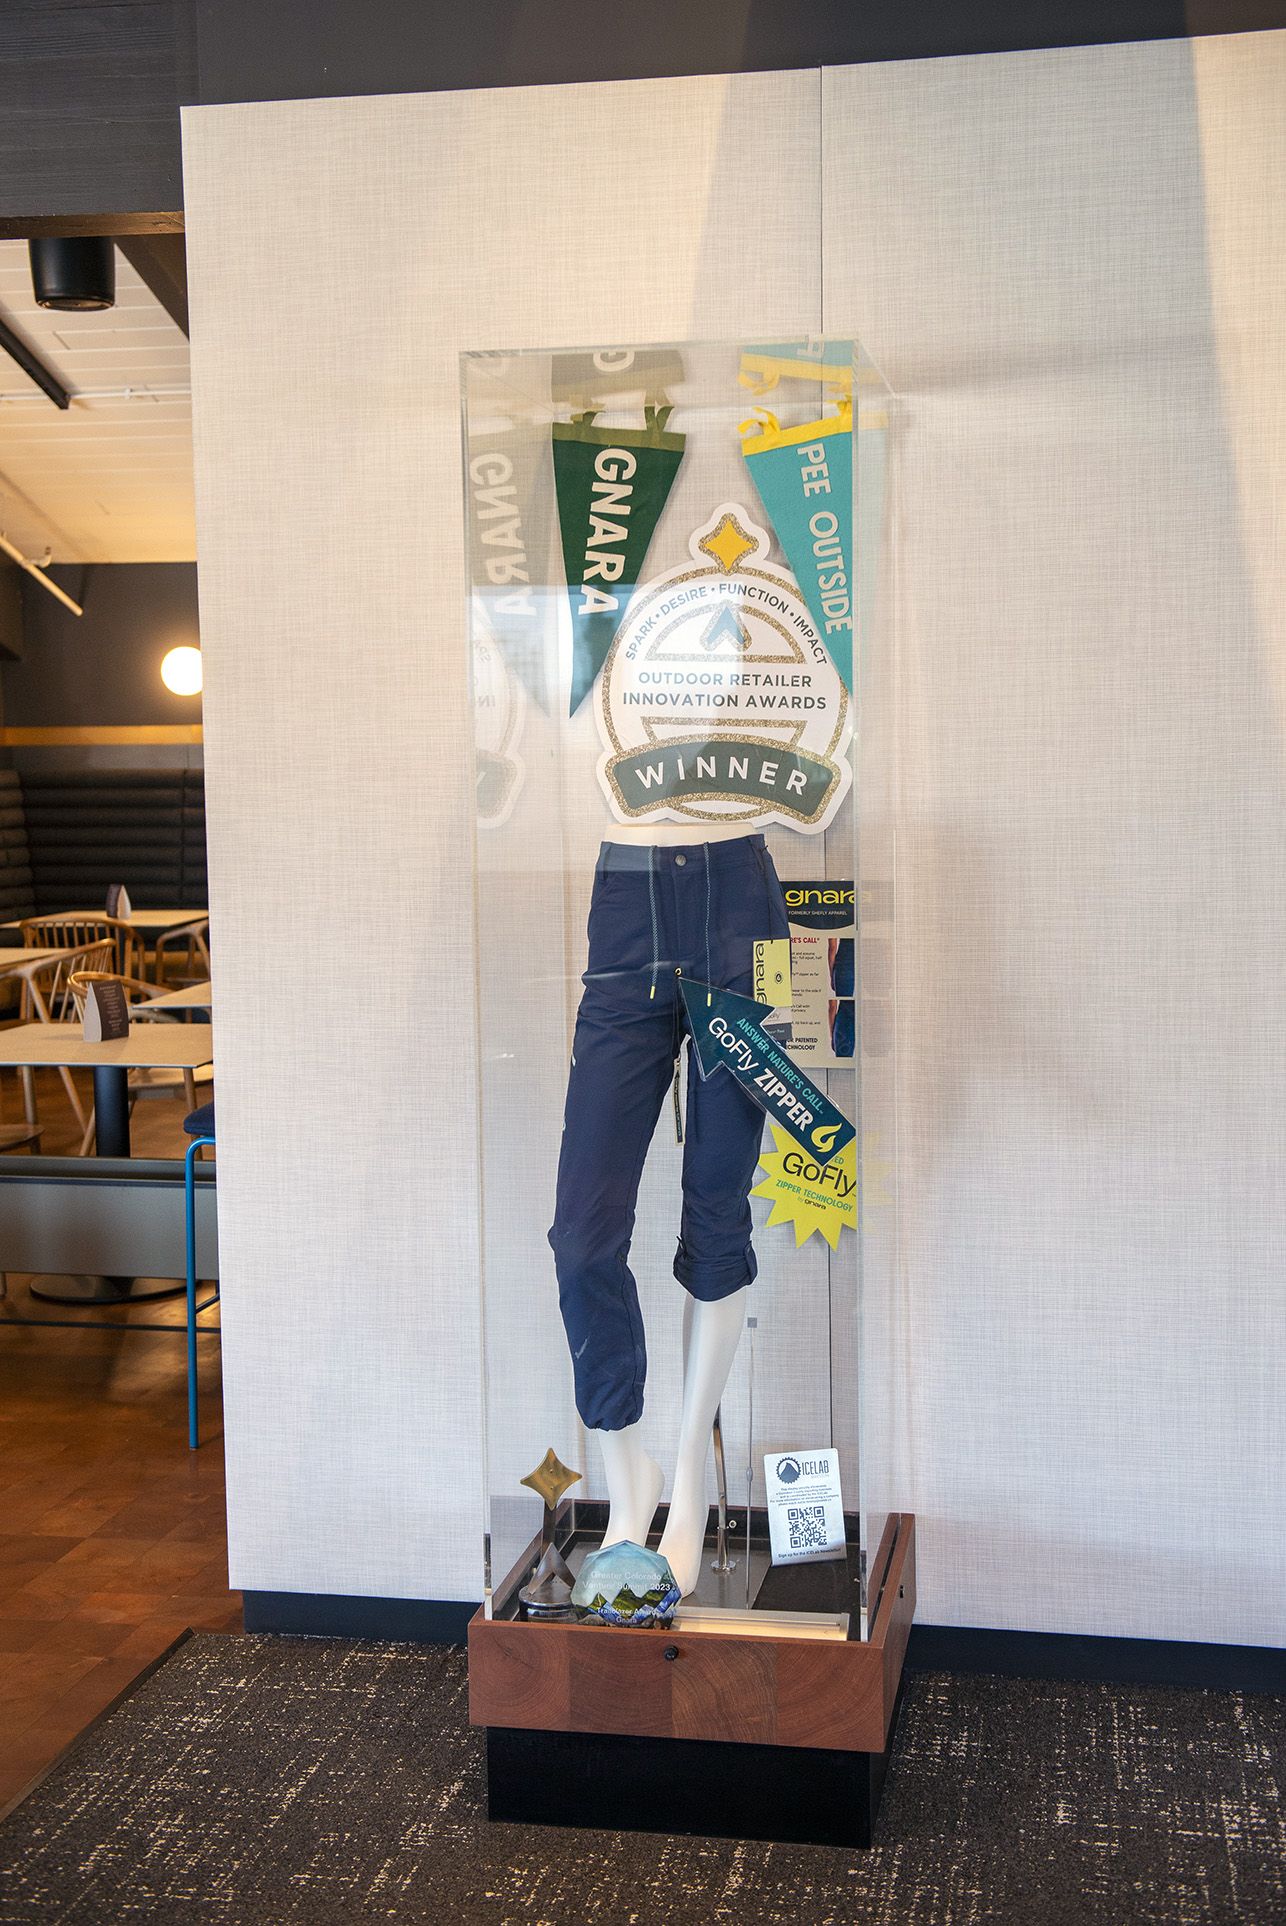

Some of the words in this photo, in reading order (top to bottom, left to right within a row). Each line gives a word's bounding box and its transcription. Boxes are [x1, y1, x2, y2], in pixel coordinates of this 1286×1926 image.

[797, 441, 832, 498] PEE
[577, 447, 638, 616] GNARA
[808, 510, 853, 635] OUTSIDE
[625, 615, 657, 661] SPARK
[658, 585, 708, 616] DESIRE
[718, 583, 789, 615] FUNCTION
[792, 615, 828, 665] IMPACT
[622, 691, 739, 708] INNOVATION
[745, 695, 827, 710] AWARDS
[638, 672, 723, 686] OUTDOOR
[729, 673, 812, 688] RETAILER
[634, 755, 808, 796] WINNER
[708, 1017, 759, 1071] GoFly
[754, 1068, 814, 1132] ZIPPER
[736, 1018, 770, 1054] ANSWER
[767, 1051, 804, 1090] NATURE'S
[782, 1152, 856, 1198] GoFly
[832, 1156, 844, 1165] ED
[776, 1179, 802, 1194] ZIPPER
[803, 1189, 853, 1212] TECHNOLOGY
[801, 1459, 830, 1476] ICELAB
[650, 1583, 671, 1591] 2023
